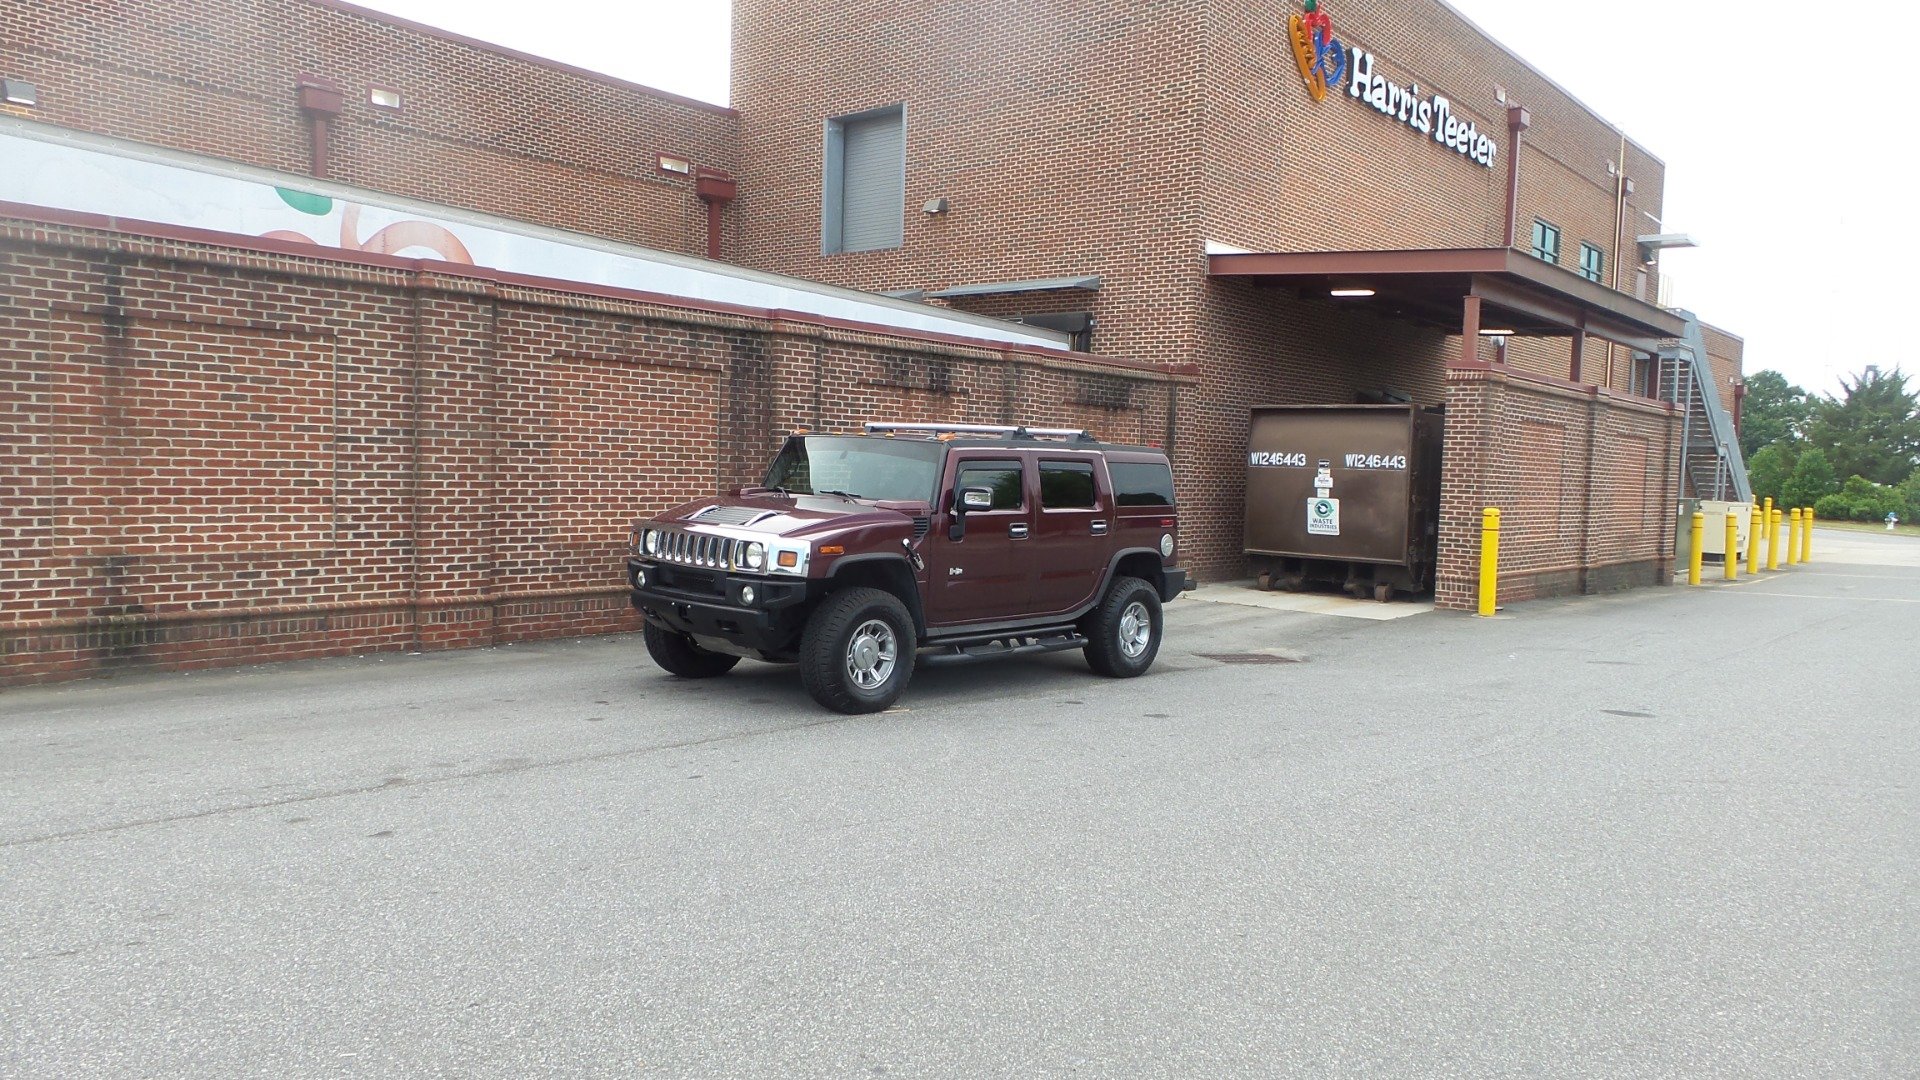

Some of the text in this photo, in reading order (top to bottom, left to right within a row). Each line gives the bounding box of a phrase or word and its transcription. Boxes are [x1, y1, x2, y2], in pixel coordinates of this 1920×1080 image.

[1350, 47, 1496, 168] Harris Teeter
[1251, 452, 1306, 466] WI246443
[1345, 453, 1406, 468] WI246443
